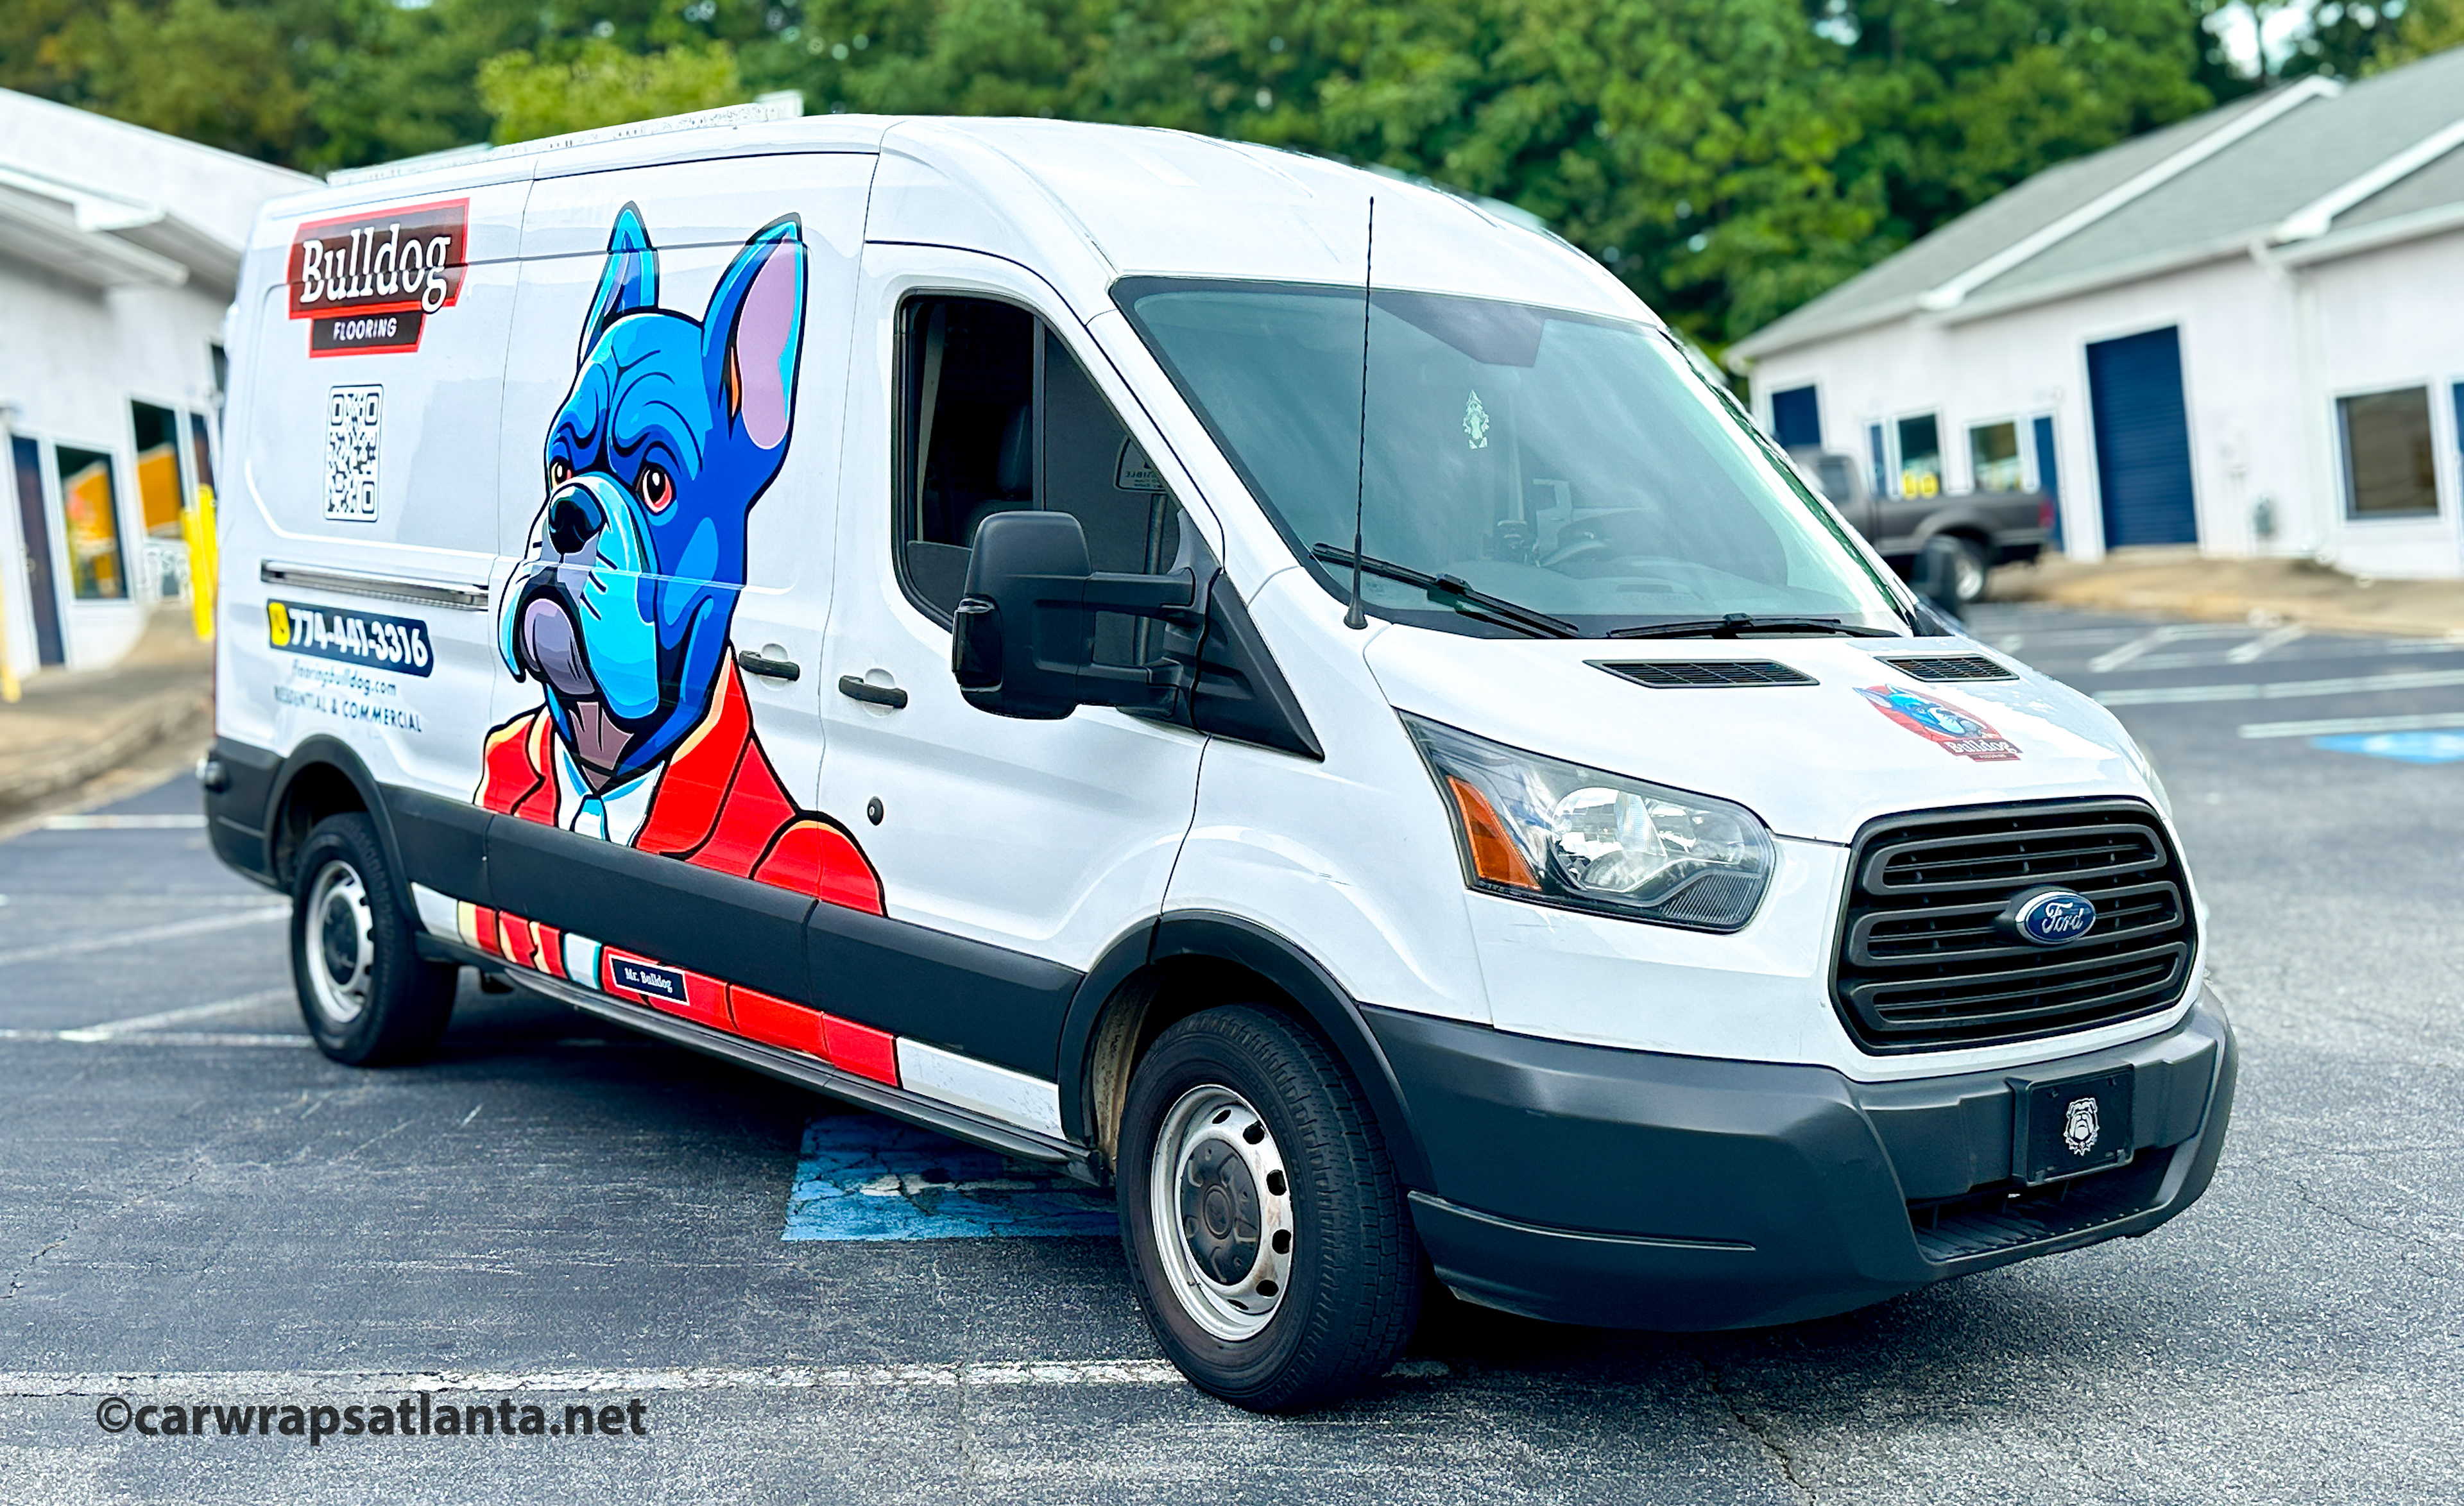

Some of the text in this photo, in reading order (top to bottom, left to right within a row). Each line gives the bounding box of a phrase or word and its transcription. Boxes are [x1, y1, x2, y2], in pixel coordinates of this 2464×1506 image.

[300, 223, 451, 313] Bulldog
[333, 317, 397, 341] FLOORING
[289, 608, 429, 667] 774-441-3316
[330, 697, 338, 715] &
[343, 701, 422, 733] COMMERCIAL
[1944, 739, 2017, 754] Bulldog
[2041, 902, 2085, 934] Ford
[624, 967, 673, 994] Mr. Bulldog
